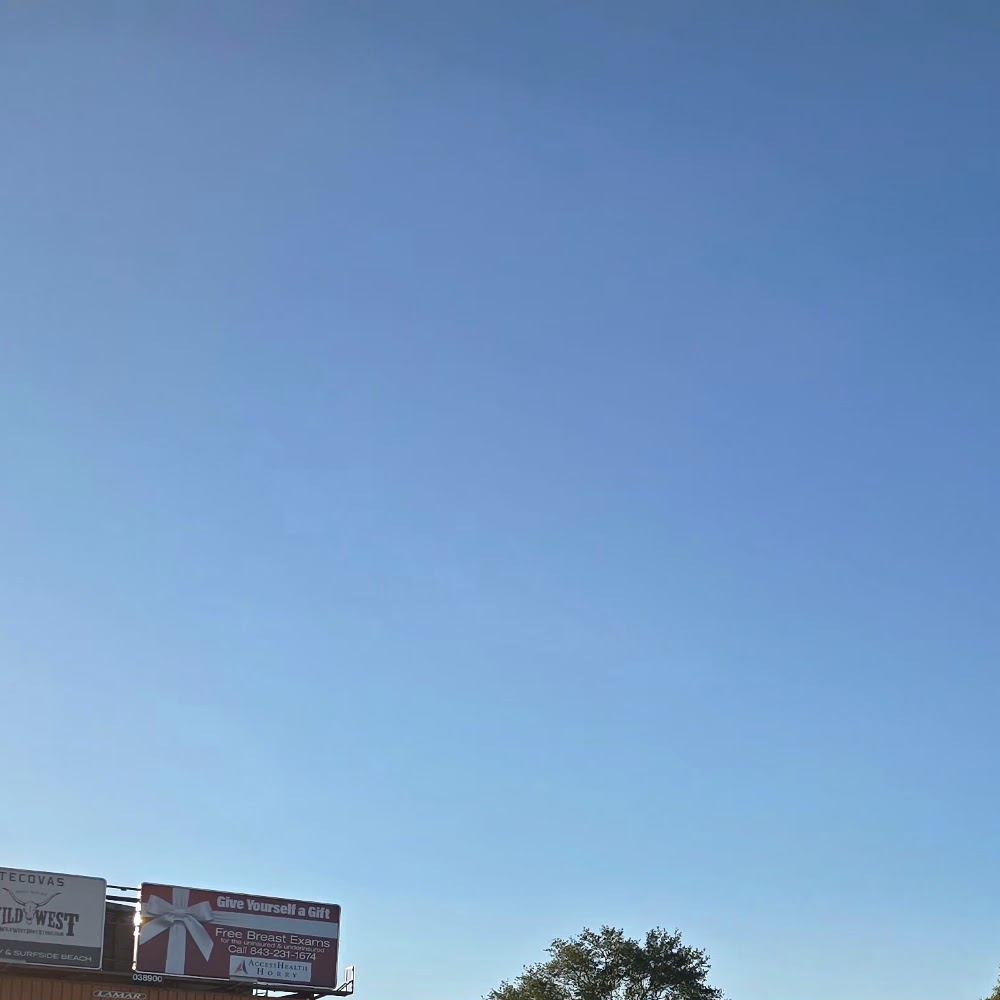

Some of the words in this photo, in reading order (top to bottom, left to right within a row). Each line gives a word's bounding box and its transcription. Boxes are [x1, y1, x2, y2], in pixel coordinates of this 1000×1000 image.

[0, 872, 64, 886] TECOVAS
[217, 896, 244, 909] Give
[247, 899, 297, 915] Yourself
[298, 908, 305, 917] a
[308, 906, 330, 919] Gift
[0, 906, 23, 924] ILD
[35, 910, 79, 936] WEST
[215, 927, 242, 939] Free
[247, 931, 286, 943] Breast
[290, 935, 330, 948] Exams
[228, 945, 247, 954] Call
[250, 947, 316, 960] 843-231-1674
[244, 940, 275, 948] uninsured
[283, 944, 325, 953] underinsured
[14, 950, 58, 960] SURFSIDE
[61, 954, 92, 962] BEACH
[132, 973, 163, 982] 038900
[256, 967, 298, 978] HORRY
[98, 991, 141, 999] LAMAR
